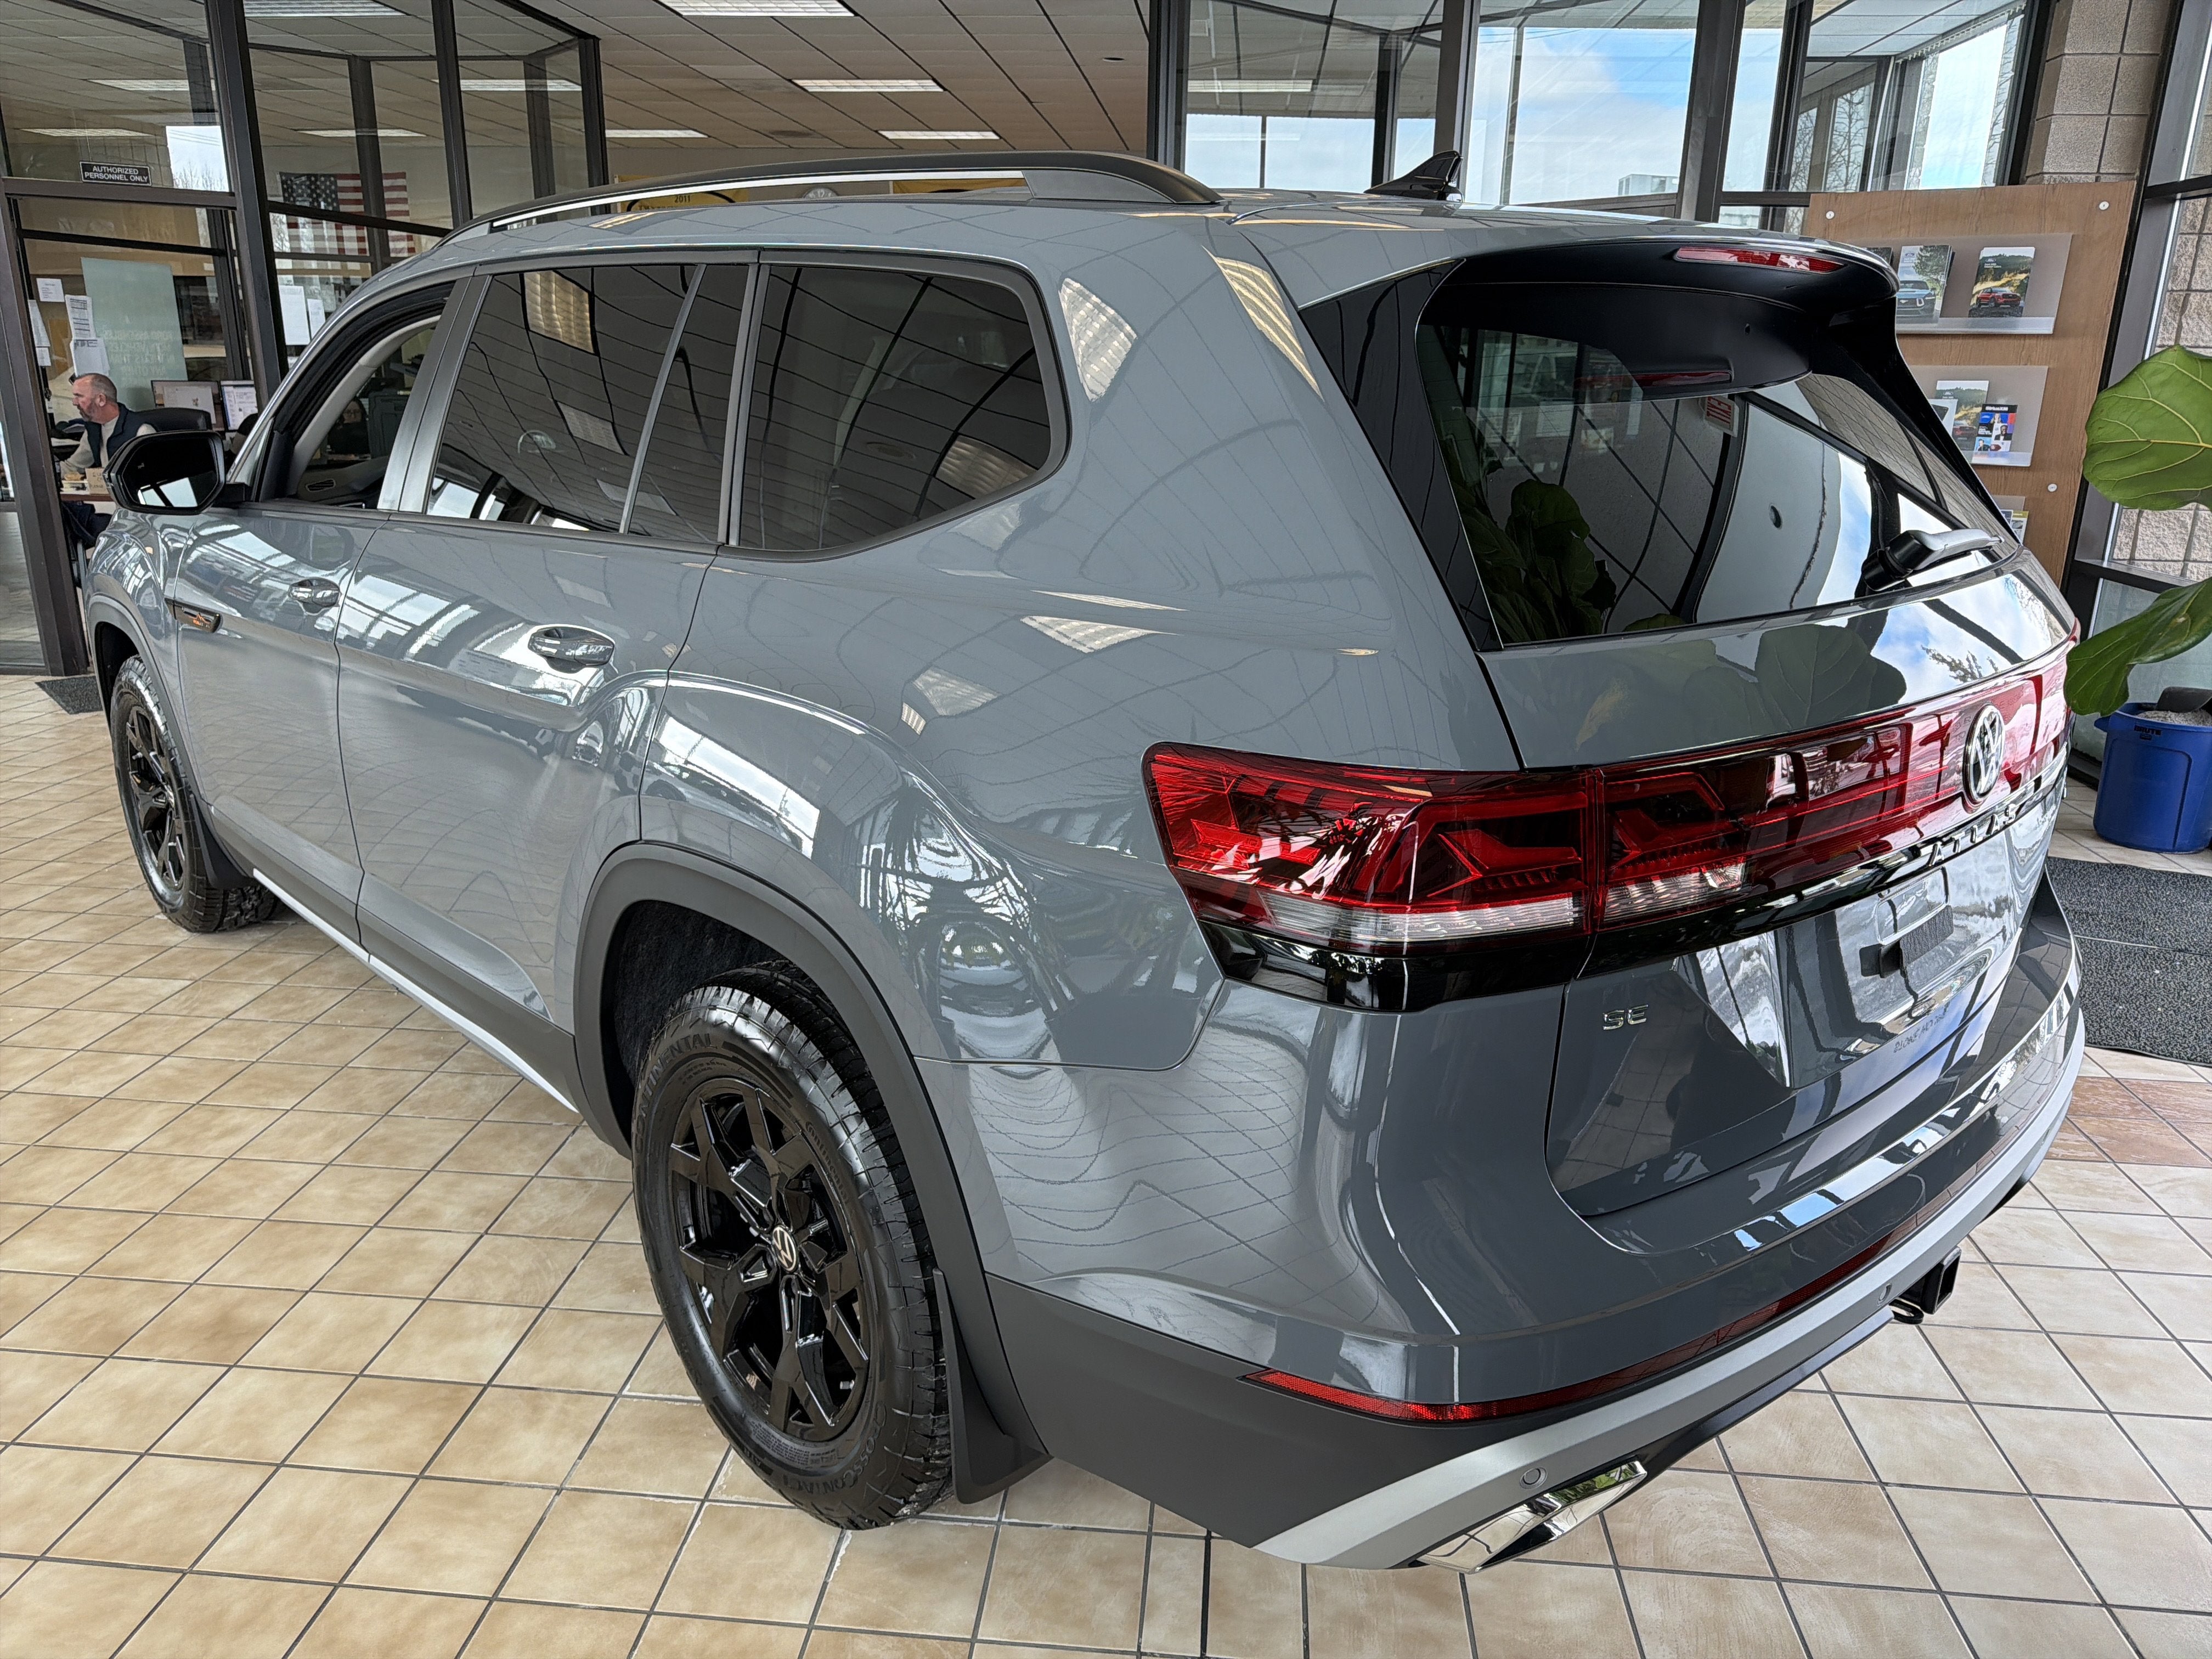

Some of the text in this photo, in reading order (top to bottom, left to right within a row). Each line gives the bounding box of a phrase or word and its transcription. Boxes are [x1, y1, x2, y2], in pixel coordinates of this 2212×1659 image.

[84, 172, 129, 181] PERSONNEL
[93, 166, 139, 175] AUTHORIZED
[674, 195, 691, 203] 2011
[1927, 803, 2017, 867] ATLAS
[1602, 1005, 1649, 1030] SE
[635, 1032, 718, 1153] CONTINENTAL
